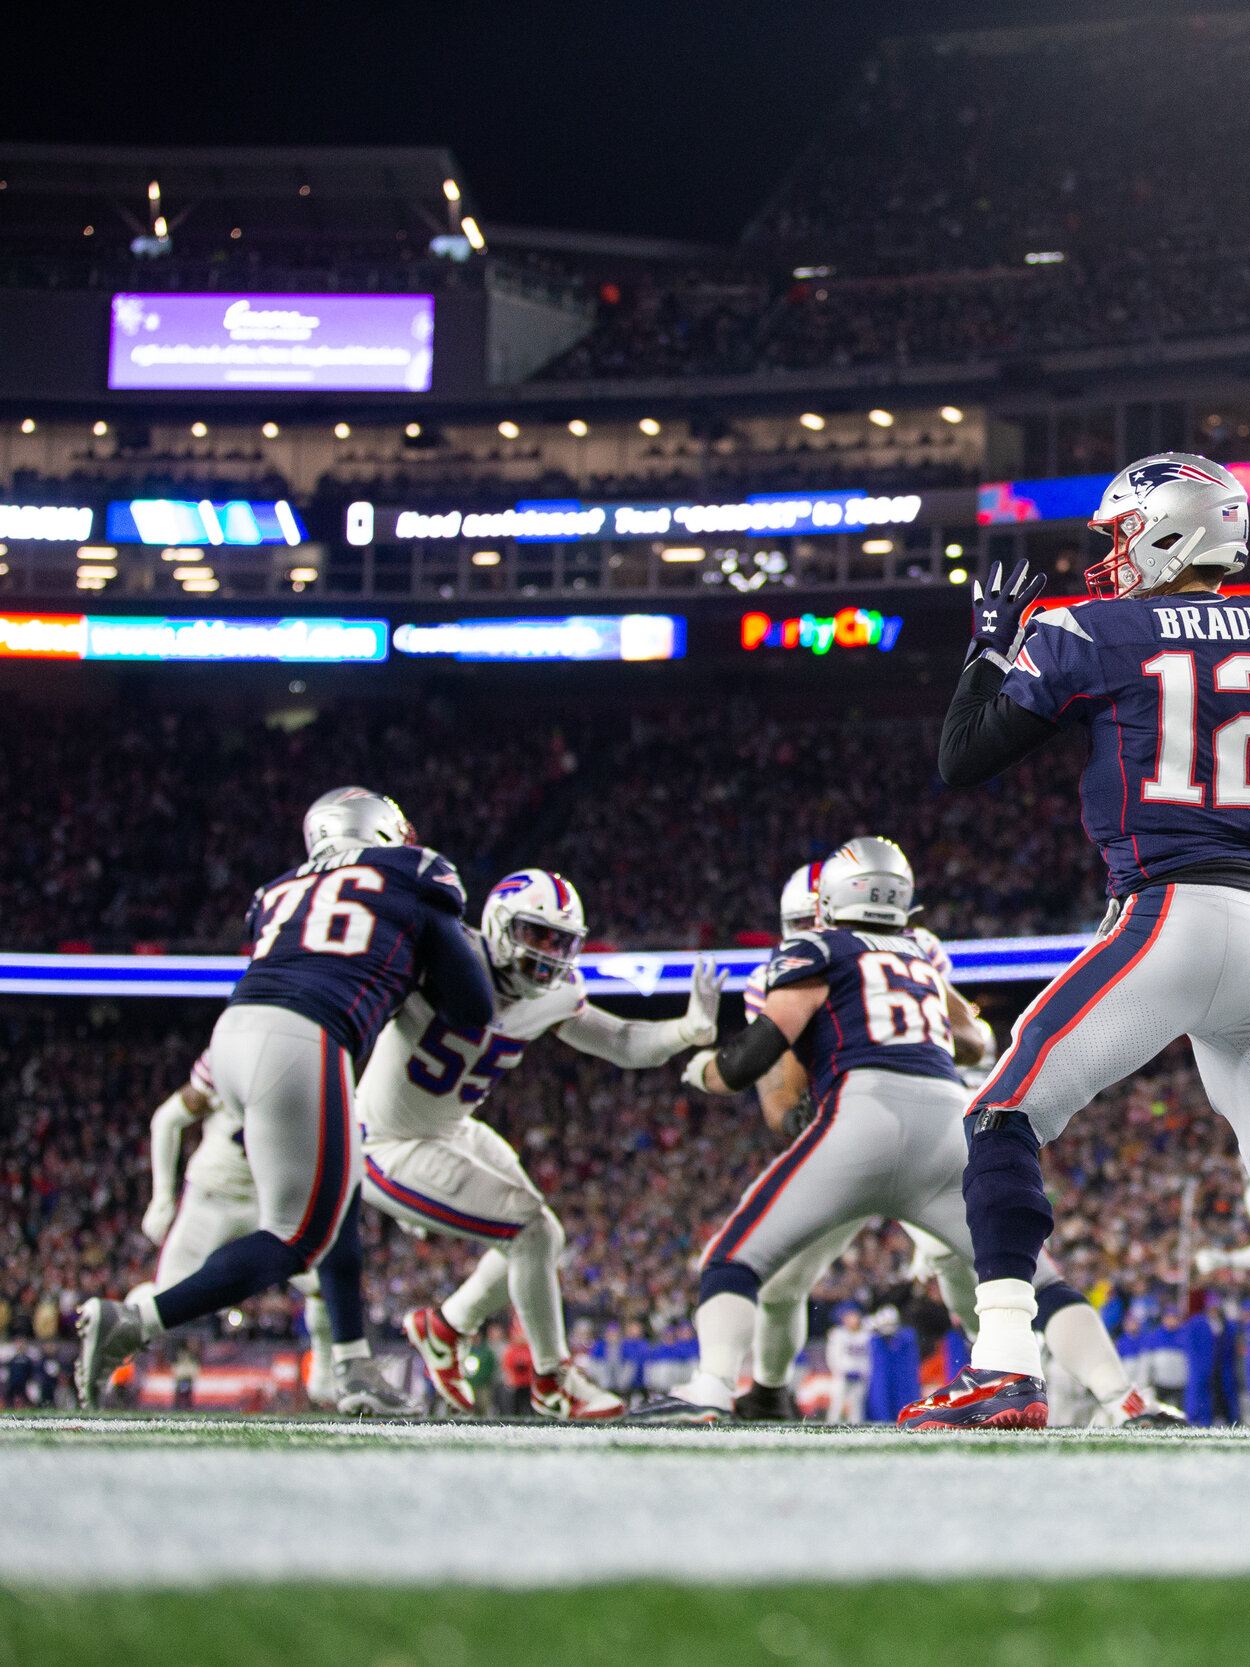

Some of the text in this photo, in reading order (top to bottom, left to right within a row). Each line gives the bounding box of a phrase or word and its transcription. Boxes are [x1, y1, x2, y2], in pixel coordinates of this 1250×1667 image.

[252, 865, 385, 961] 76
[857, 950, 956, 1058] 62
[406, 1014, 530, 1105] 55
